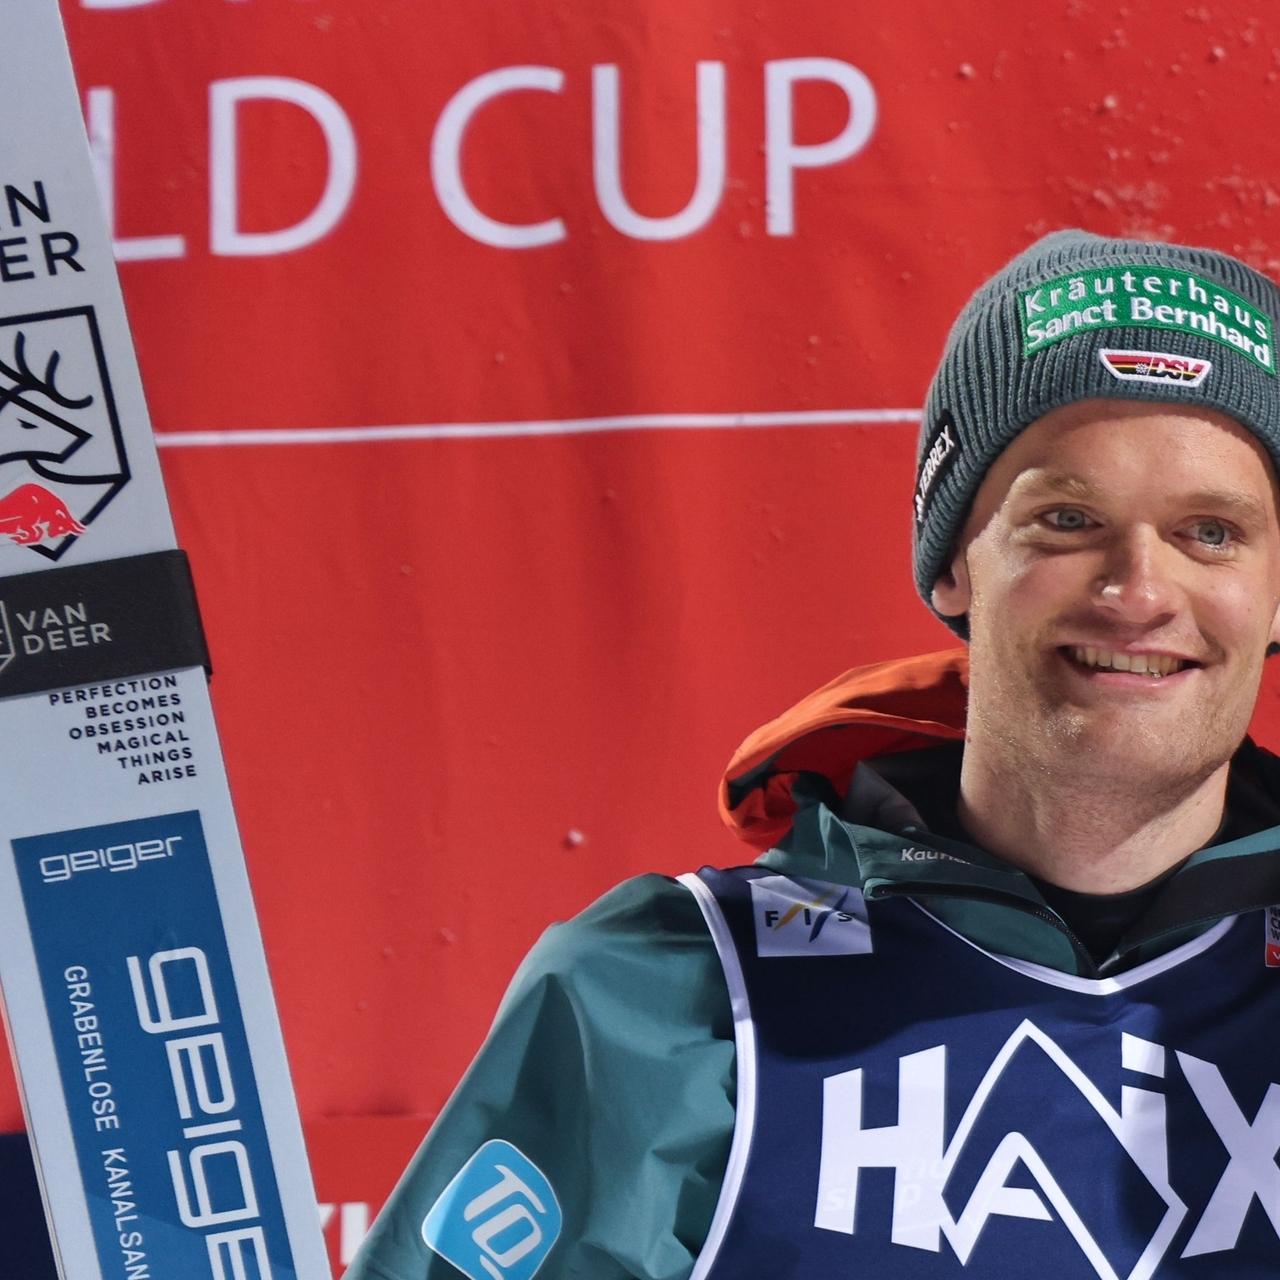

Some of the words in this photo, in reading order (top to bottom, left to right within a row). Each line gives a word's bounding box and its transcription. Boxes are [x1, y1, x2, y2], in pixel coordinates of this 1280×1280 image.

[430, 56, 878, 249] CUP
[1024, 270, 1269, 340] Kräuterhaus
[1027, 298, 1127, 351] Sanct
[1131, 297, 1270, 366] Bernhard
[1149, 356, 1210, 382] DSV
[919, 424, 955, 499] TERREX
[16, 602, 87, 631] VAN
[22, 622, 112, 655] DEER
[49, 675, 178, 706] PERFECTION
[85, 693, 182, 719] BECOMES
[69, 711, 186, 740] OBSESSION
[97, 730, 190, 755] MAGICAL
[118, 747, 193, 770] THINGS
[137, 765, 197, 785] ARISE
[39, 836, 182, 883] geiger
[765, 908, 854, 927] FIS
[64, 965, 119, 1132] GRABENLOSE
